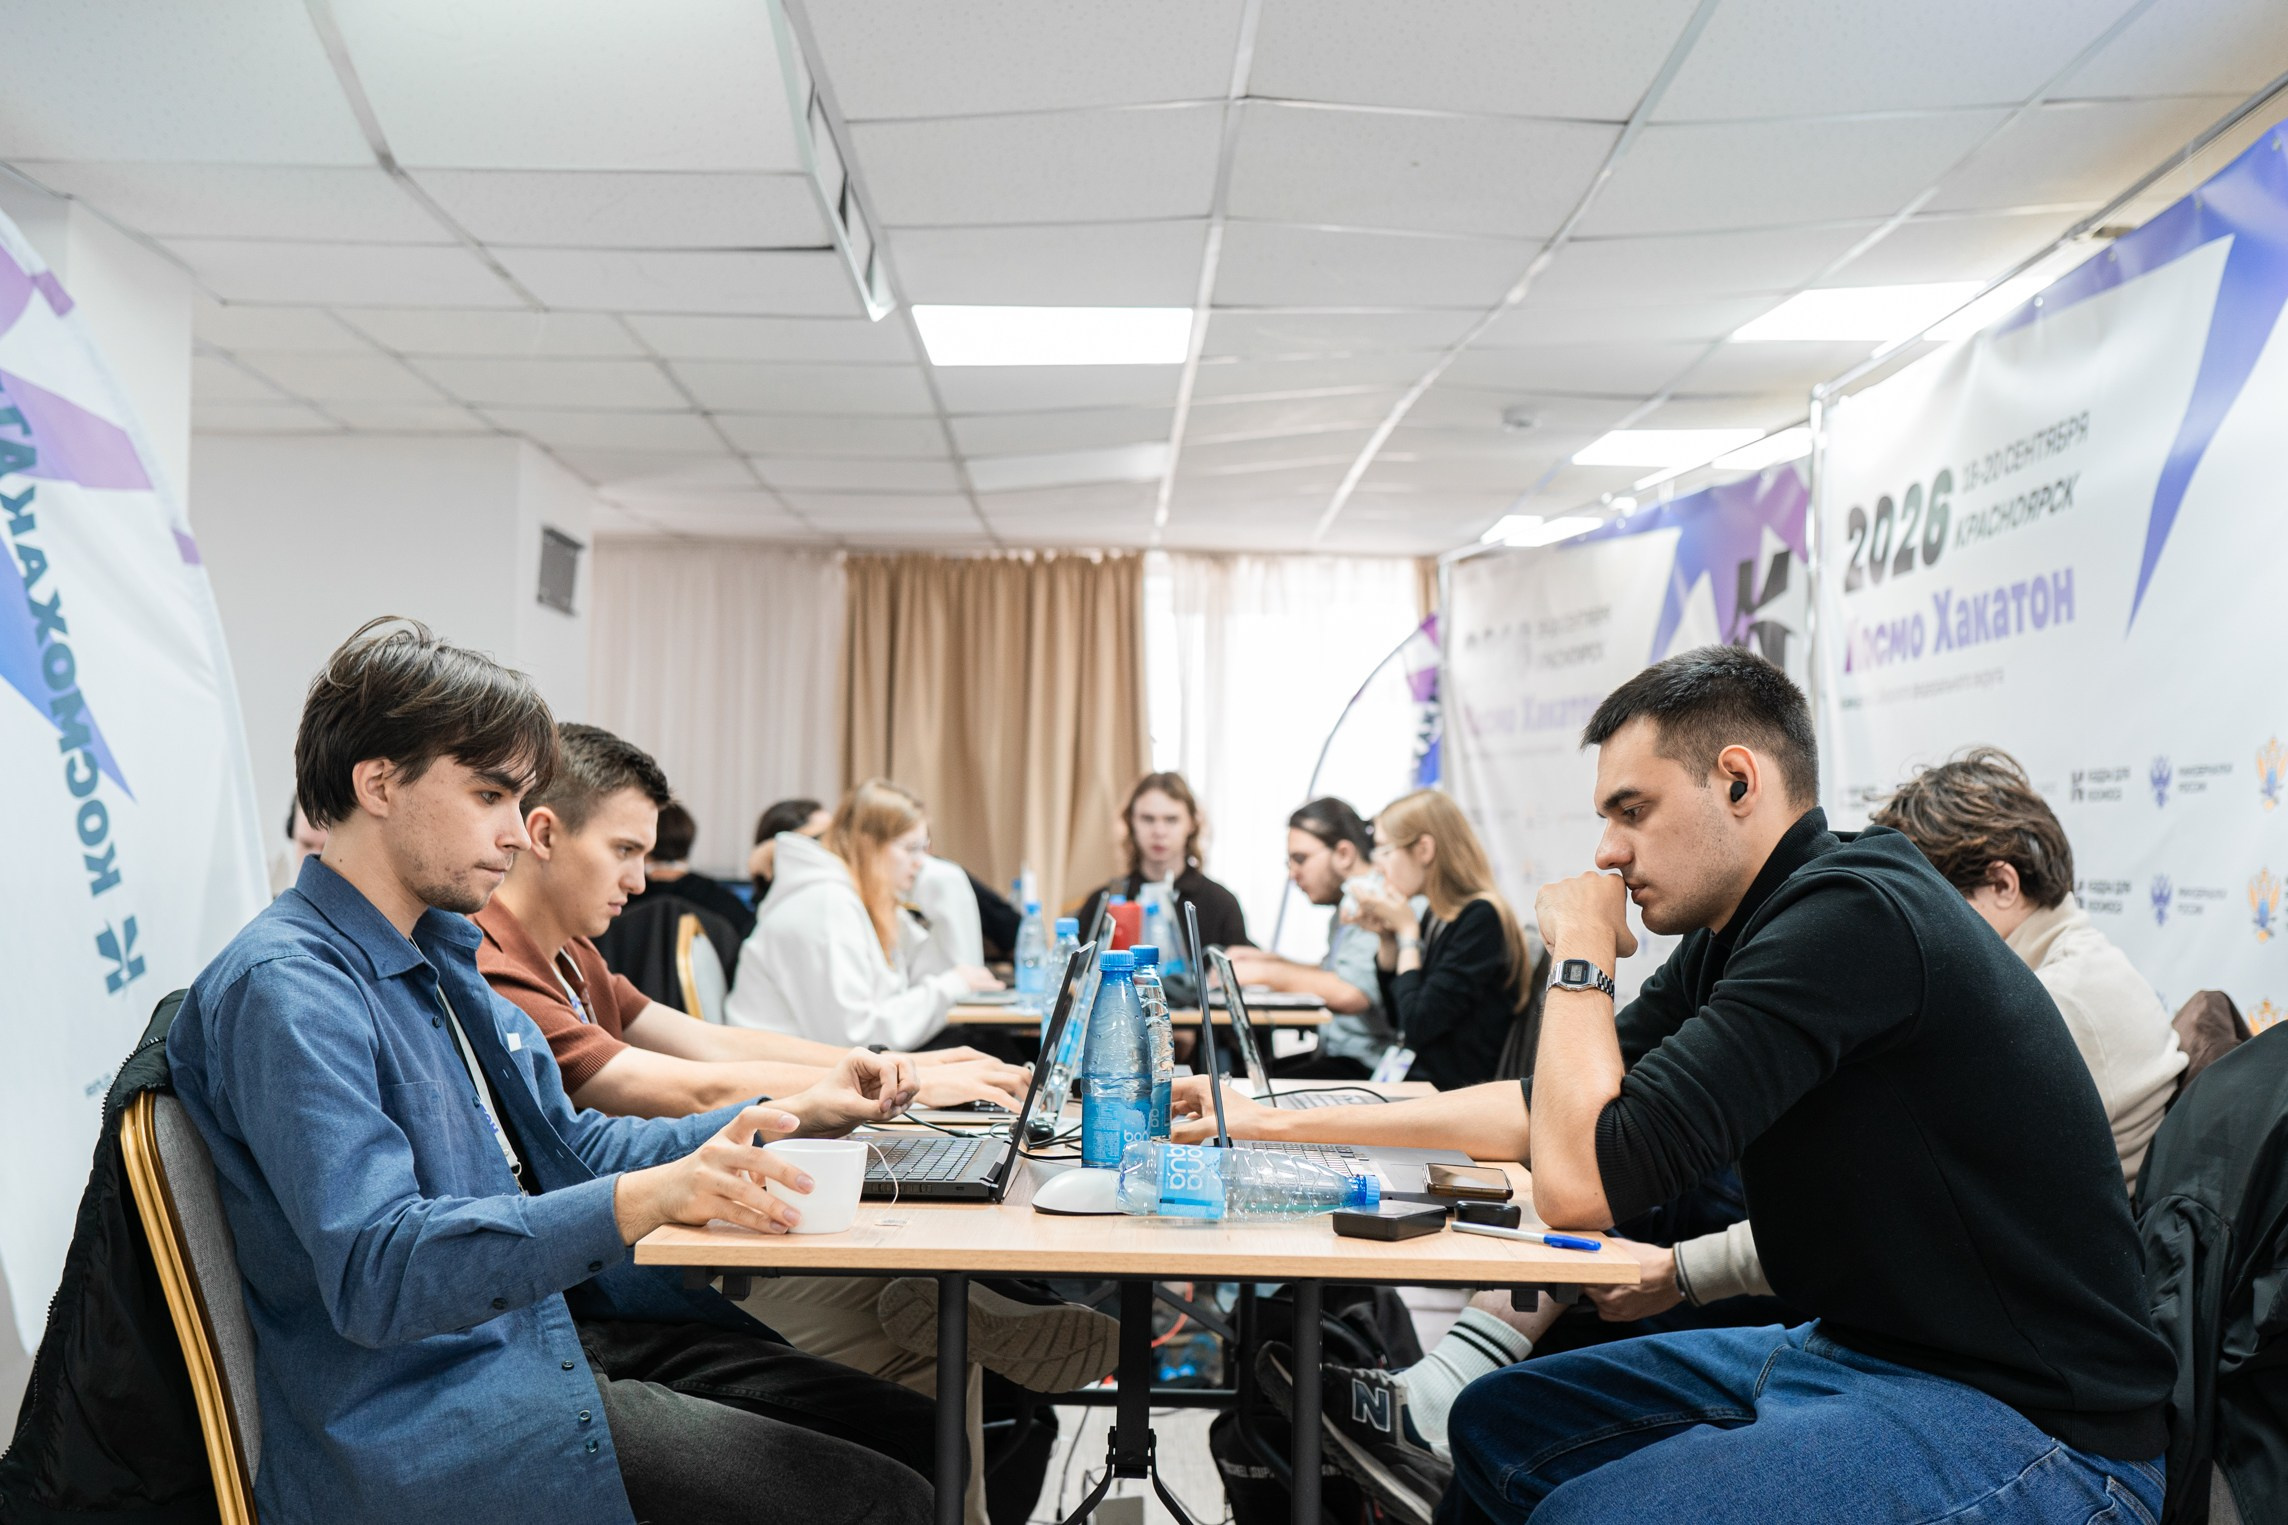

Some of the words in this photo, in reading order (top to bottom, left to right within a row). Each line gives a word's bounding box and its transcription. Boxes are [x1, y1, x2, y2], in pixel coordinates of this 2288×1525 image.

[2003, 410, 2090, 475] СЕНТЯБРЯ
[1844, 467, 1955, 593] 2026
[1955, 470, 2081, 548] КРАСНОЯРСК
[1932, 568, 2075, 655] Хакатон
[1166, 1144, 1186, 1191] qua
[1187, 1145, 1205, 1191] ona
[1352, 1378, 1391, 1433] N
